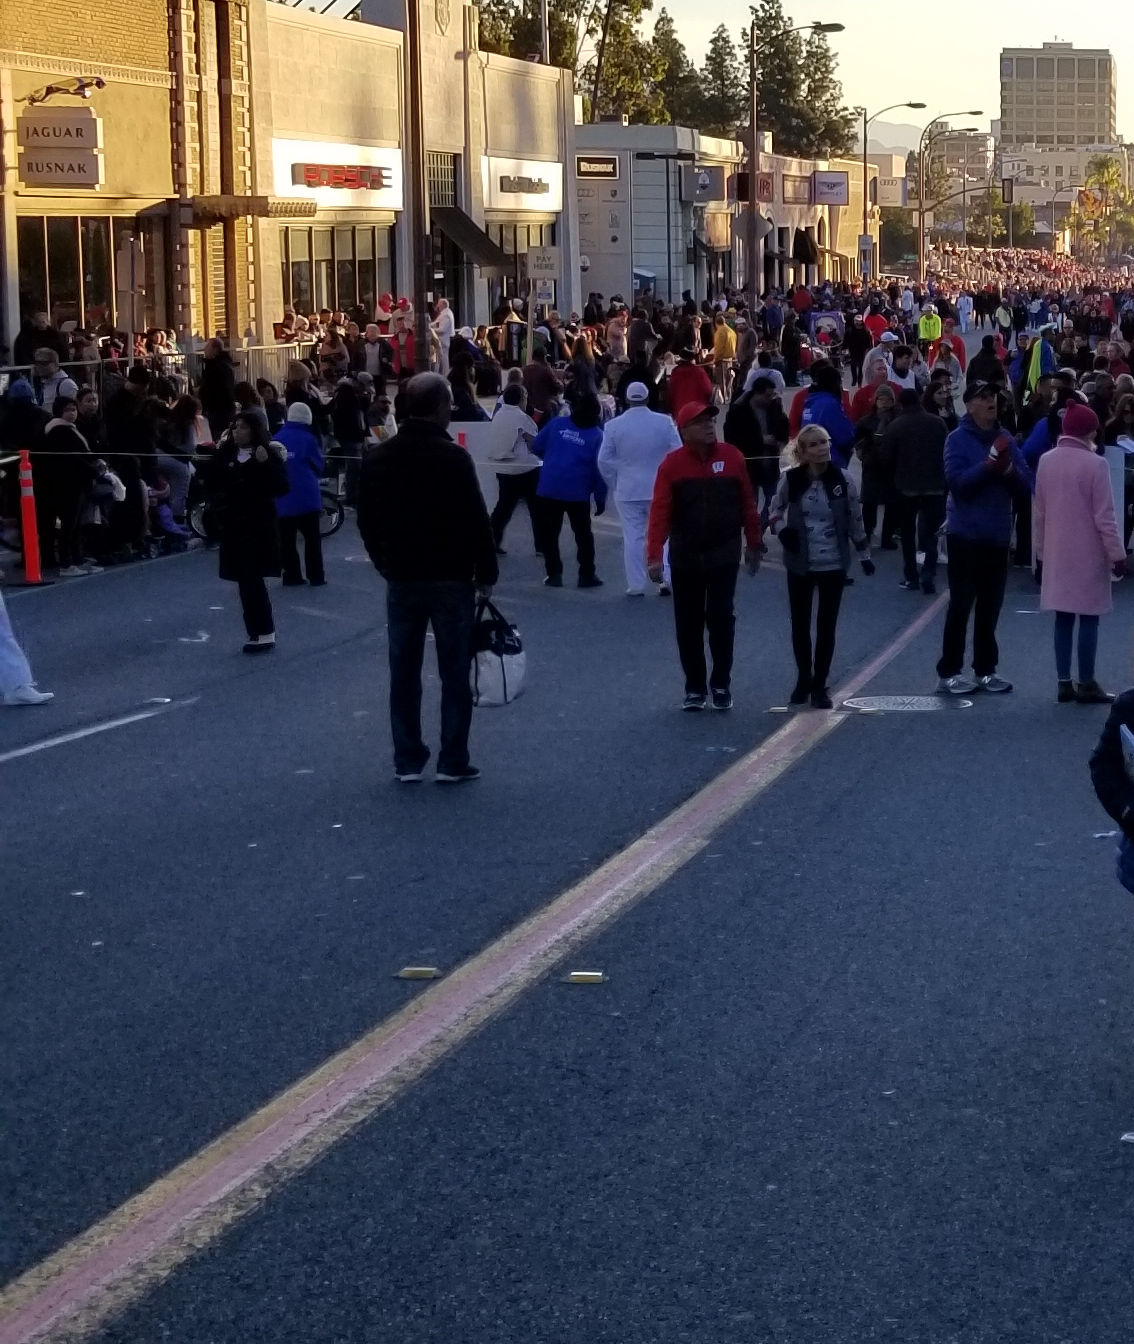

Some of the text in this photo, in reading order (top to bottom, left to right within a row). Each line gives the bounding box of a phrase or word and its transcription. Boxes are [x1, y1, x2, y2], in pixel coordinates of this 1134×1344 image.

[26, 126, 85, 140] JAGUAR
[27, 162, 87, 174] RUSNAK
[291, 163, 393, 190] PORSCHE
[533, 263, 555, 271] HERE
